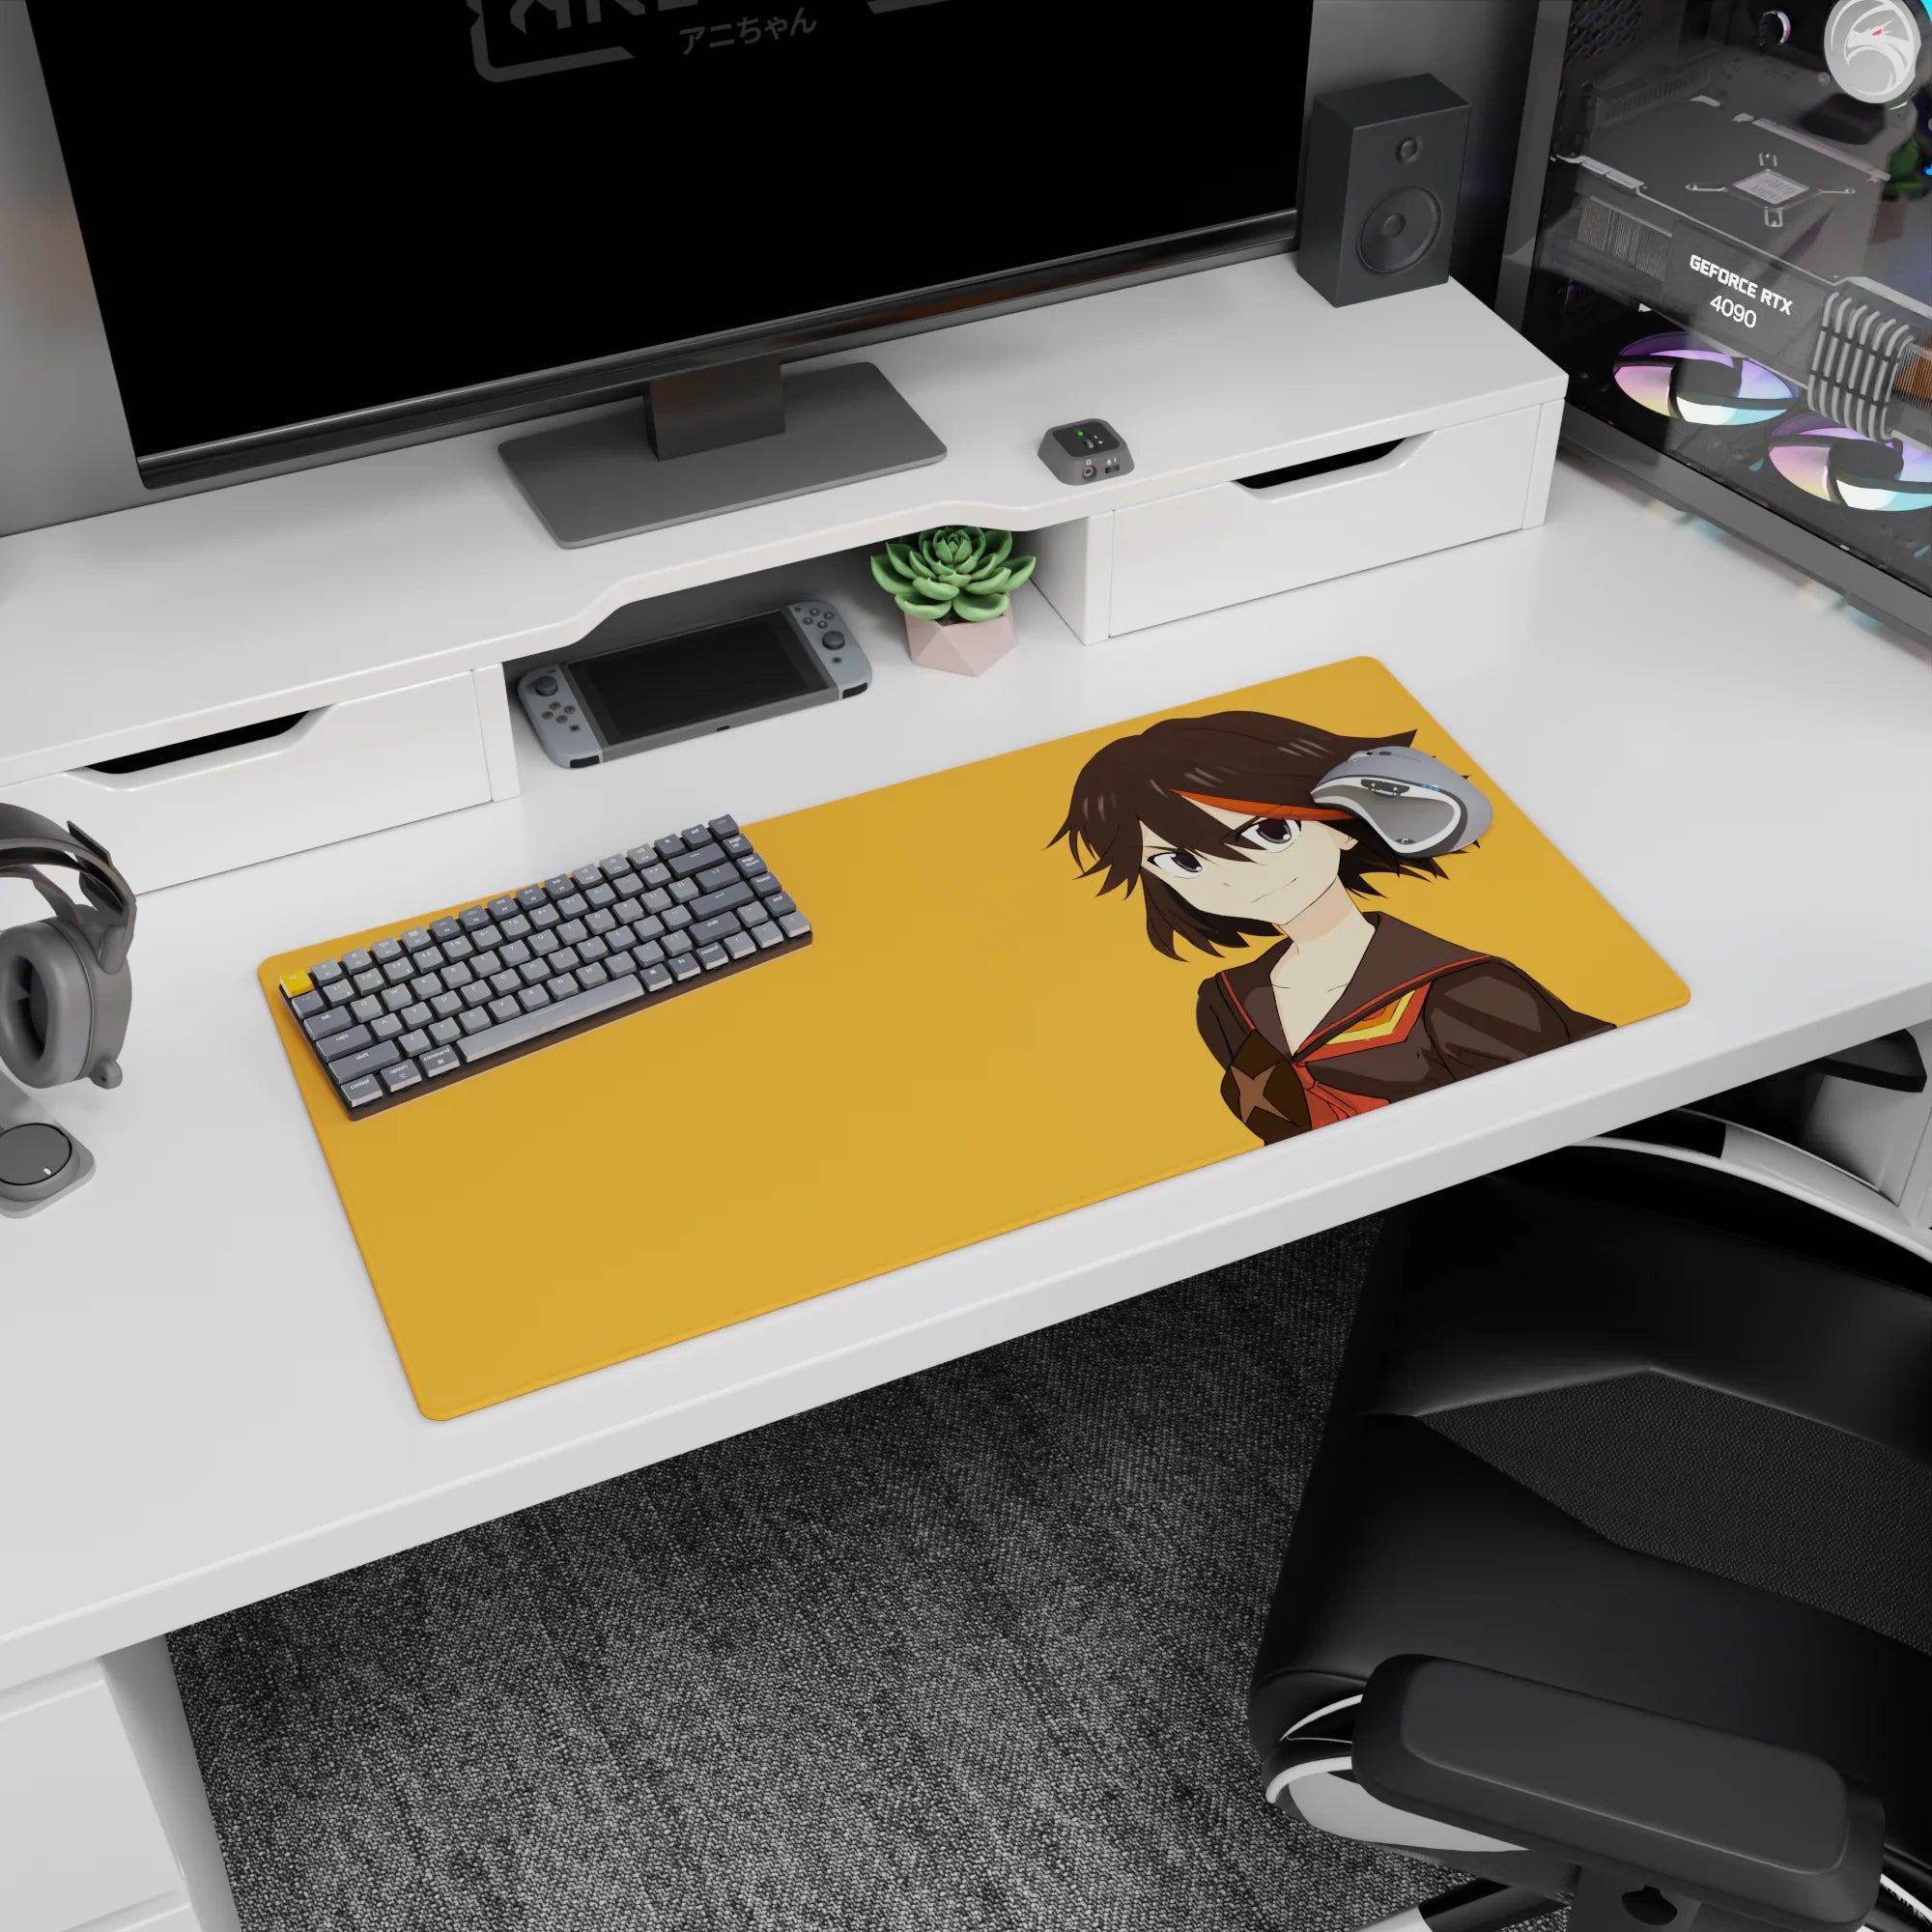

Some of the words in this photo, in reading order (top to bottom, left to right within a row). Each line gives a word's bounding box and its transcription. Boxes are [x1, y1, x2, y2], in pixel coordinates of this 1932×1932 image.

[679, 7, 816, 55] アニちゃん
[1690, 254, 1758, 298] GEFORCE
[1760, 288, 1793, 315] RTX
[1710, 295, 1757, 328] 4090
[700, 945, 719, 954] control
[423, 1047, 451, 1061] command
[389, 1065, 408, 1075] option
[350, 1079, 370, 1090] control
